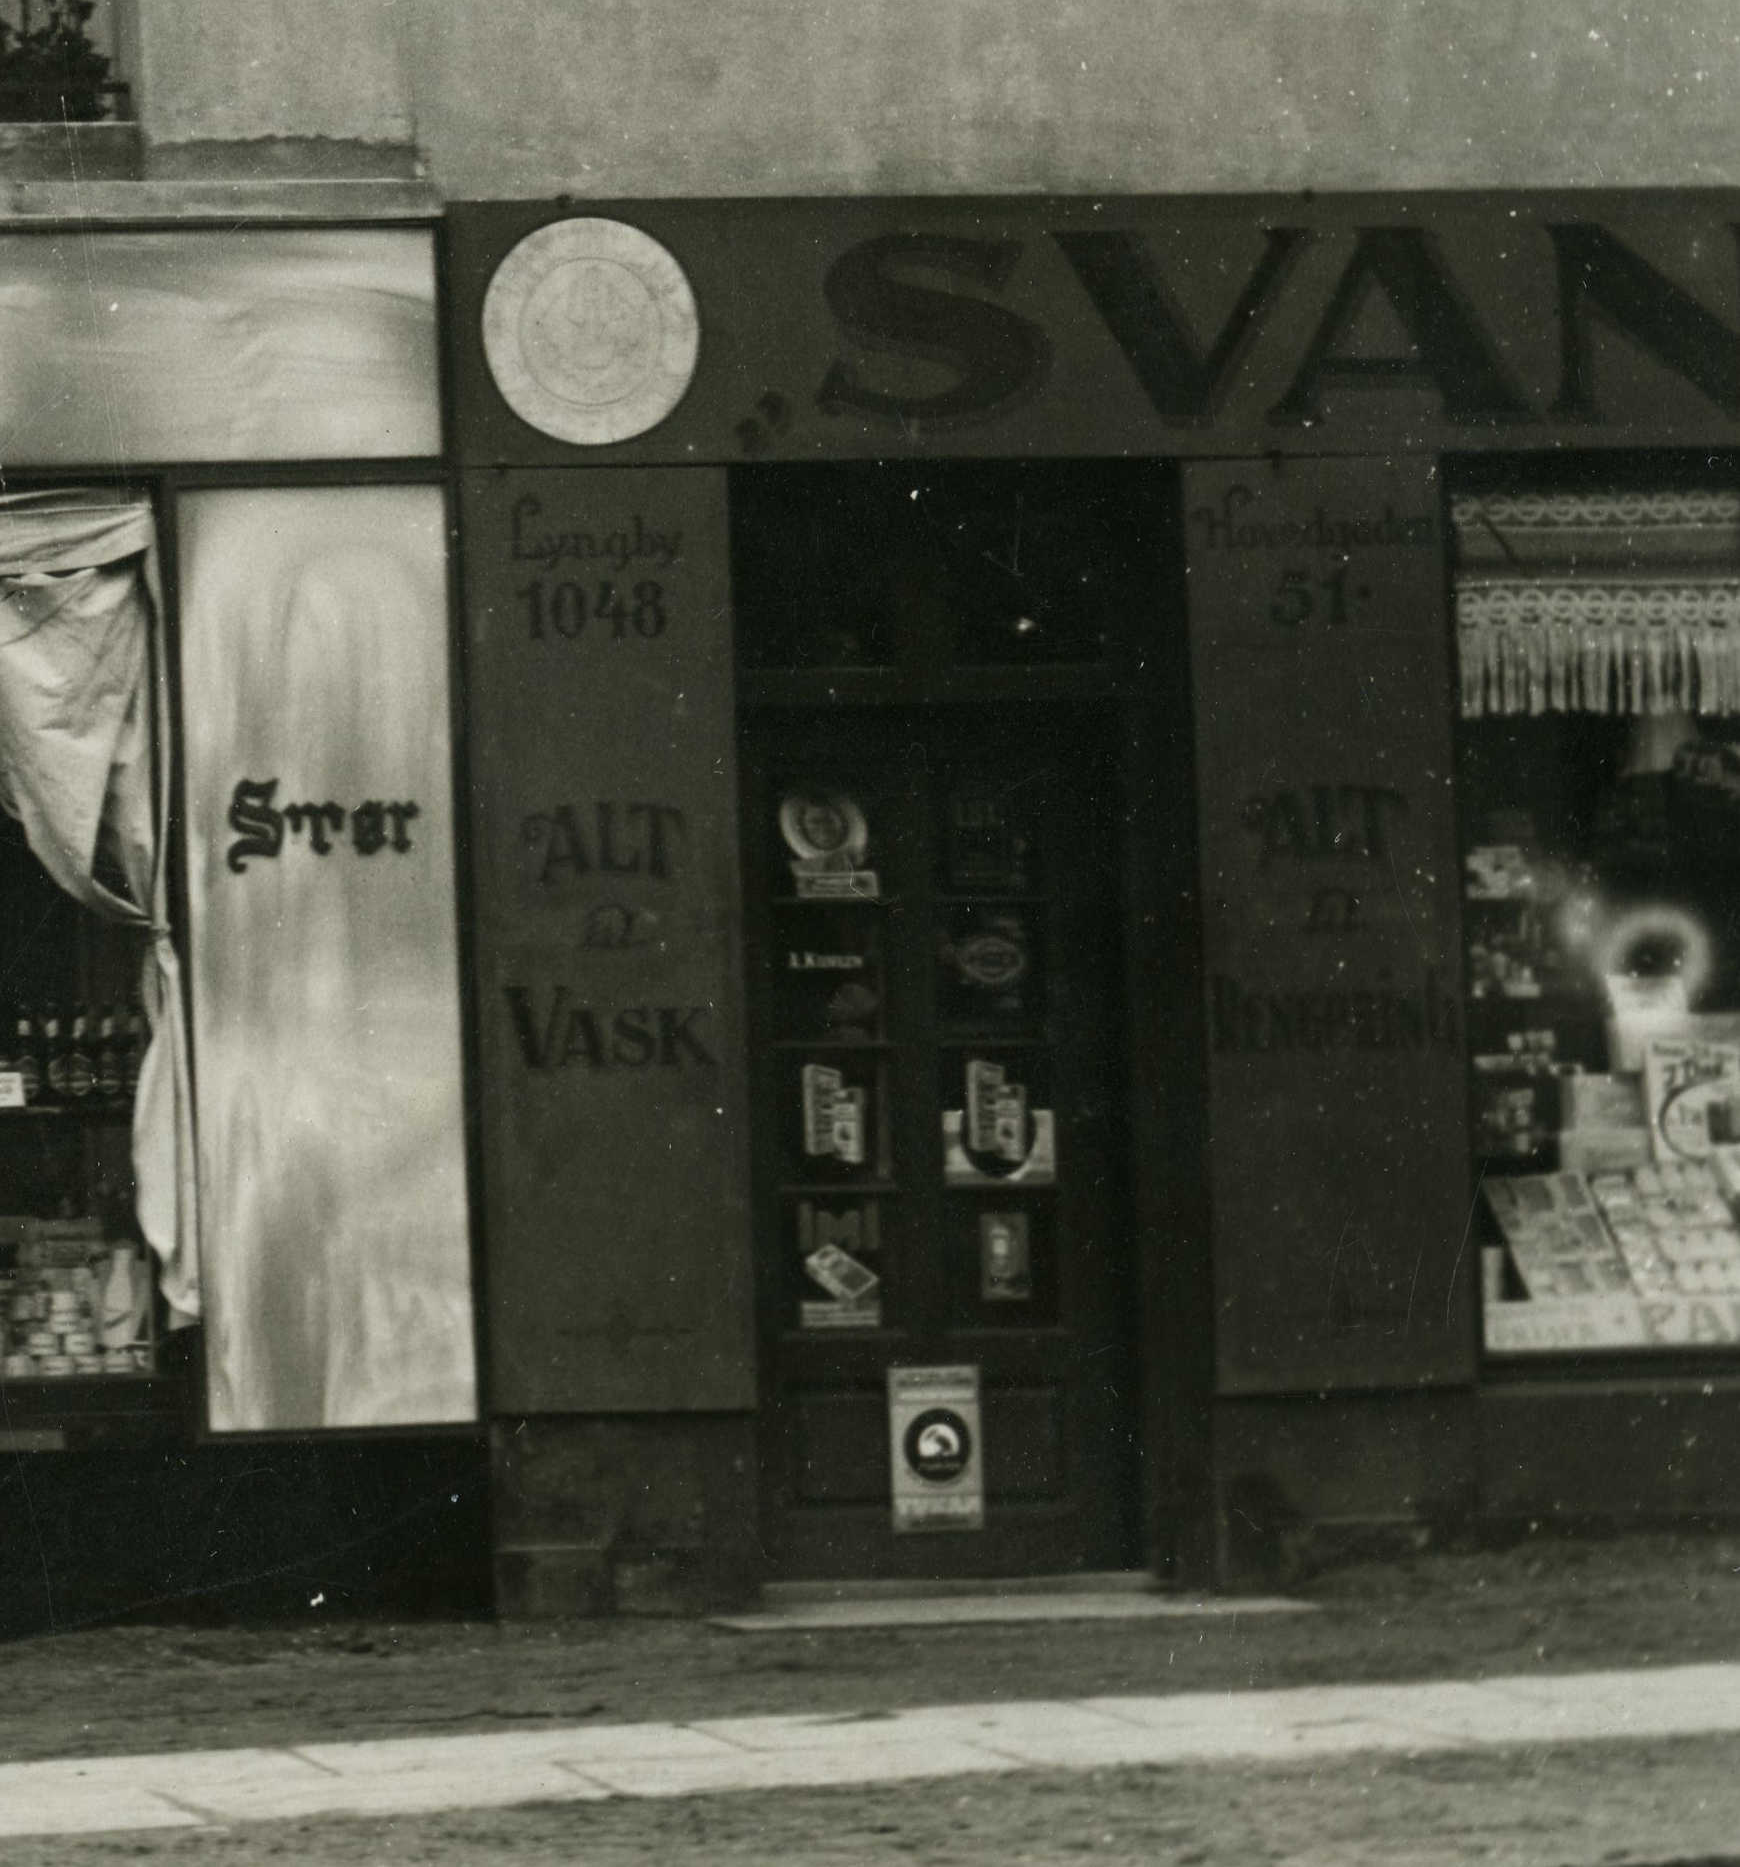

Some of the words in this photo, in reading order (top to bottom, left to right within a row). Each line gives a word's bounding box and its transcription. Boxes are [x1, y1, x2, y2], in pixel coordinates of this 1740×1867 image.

[511, 493, 685, 571] Lyngby
[517, 580, 668, 639] 1048
[226, 777, 419, 874] Smør
[521, 799, 687, 884] ALT
[500, 983, 719, 1071] VASK
